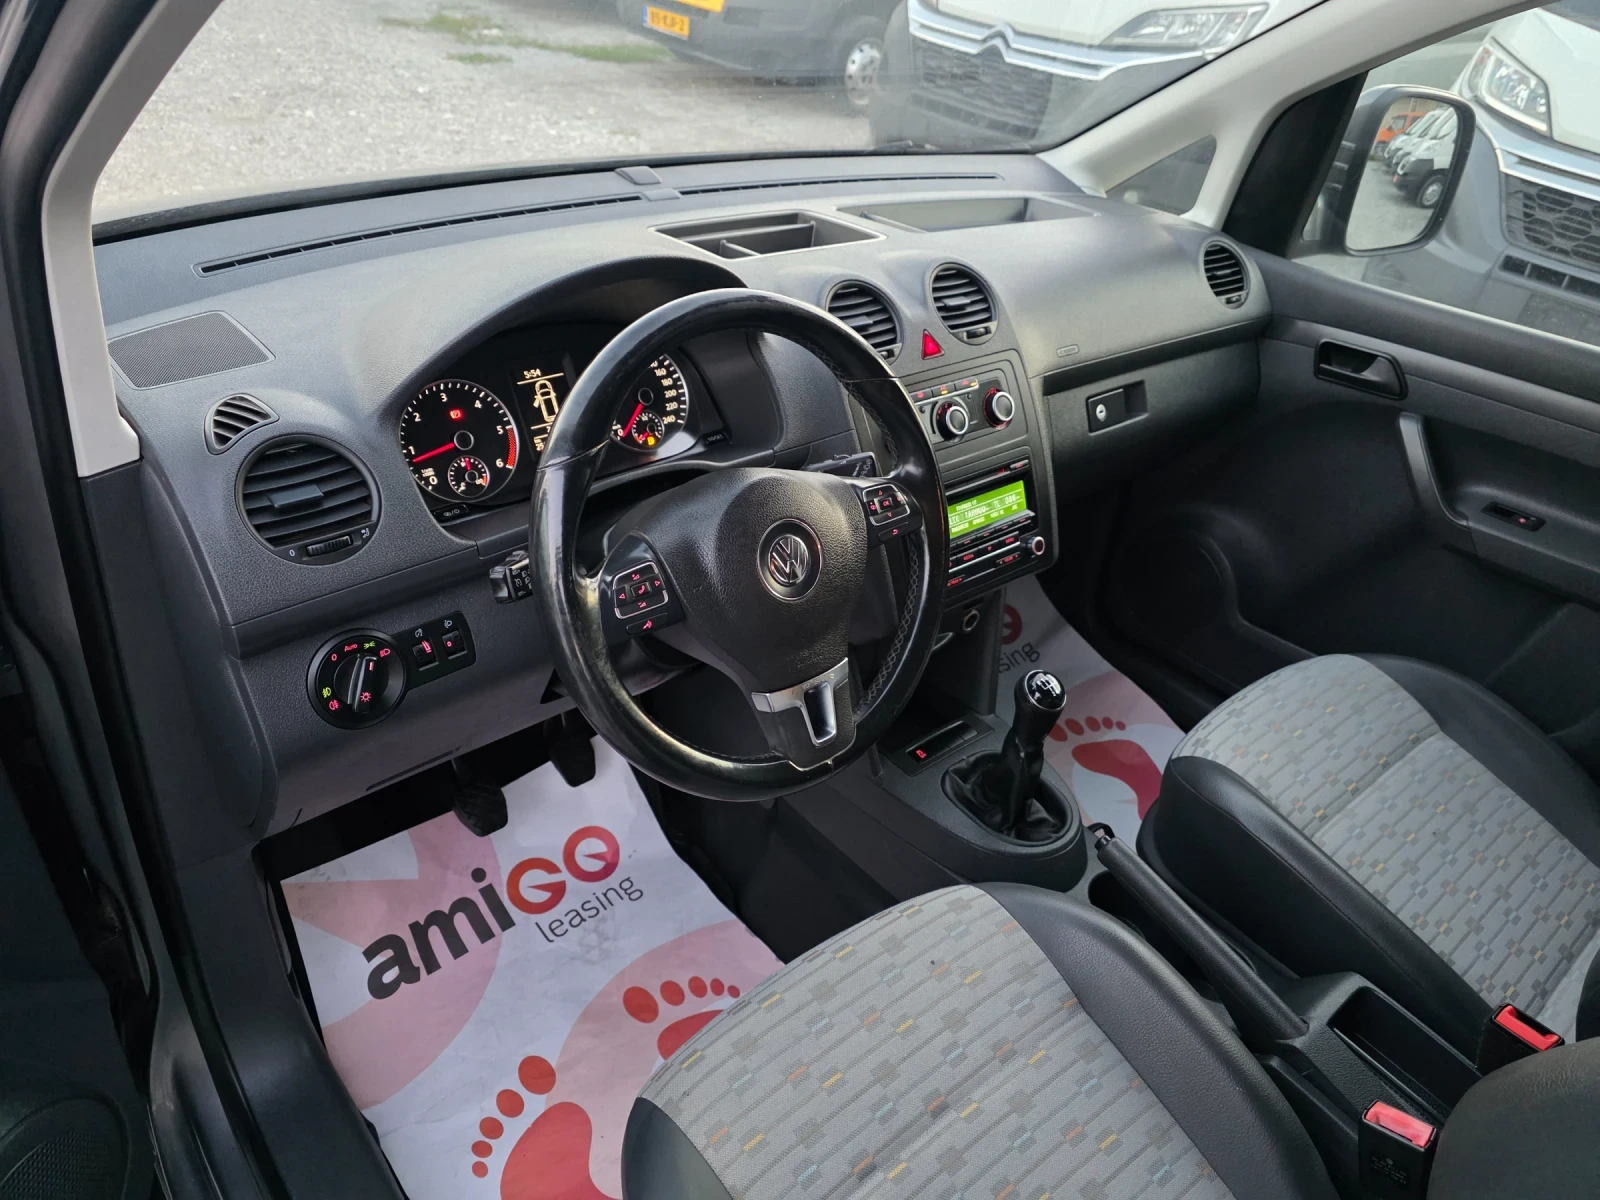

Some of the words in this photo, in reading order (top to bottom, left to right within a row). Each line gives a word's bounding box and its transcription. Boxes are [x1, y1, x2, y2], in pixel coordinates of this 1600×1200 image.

[654, 368, 667, 377] 160
[661, 378, 673, 386] 180
[440, 393, 448, 402] 3
[664, 389, 677, 398] 200
[474, 400, 482, 409] 4
[665, 402, 678, 411] 220
[413, 412, 421, 422] 2
[662, 415, 676, 424] 240
[496, 425, 504, 435] 5
[408, 446, 415, 455] 1
[496, 459, 504, 468] 6
[429, 475, 438, 485] 0
[289, 549, 296, 557] 0
[344, 643, 358, 652] Auto
[331, 653, 338, 661] 0
[999, 641, 1040, 674] sing
[534, 876, 644, 943] leasing
